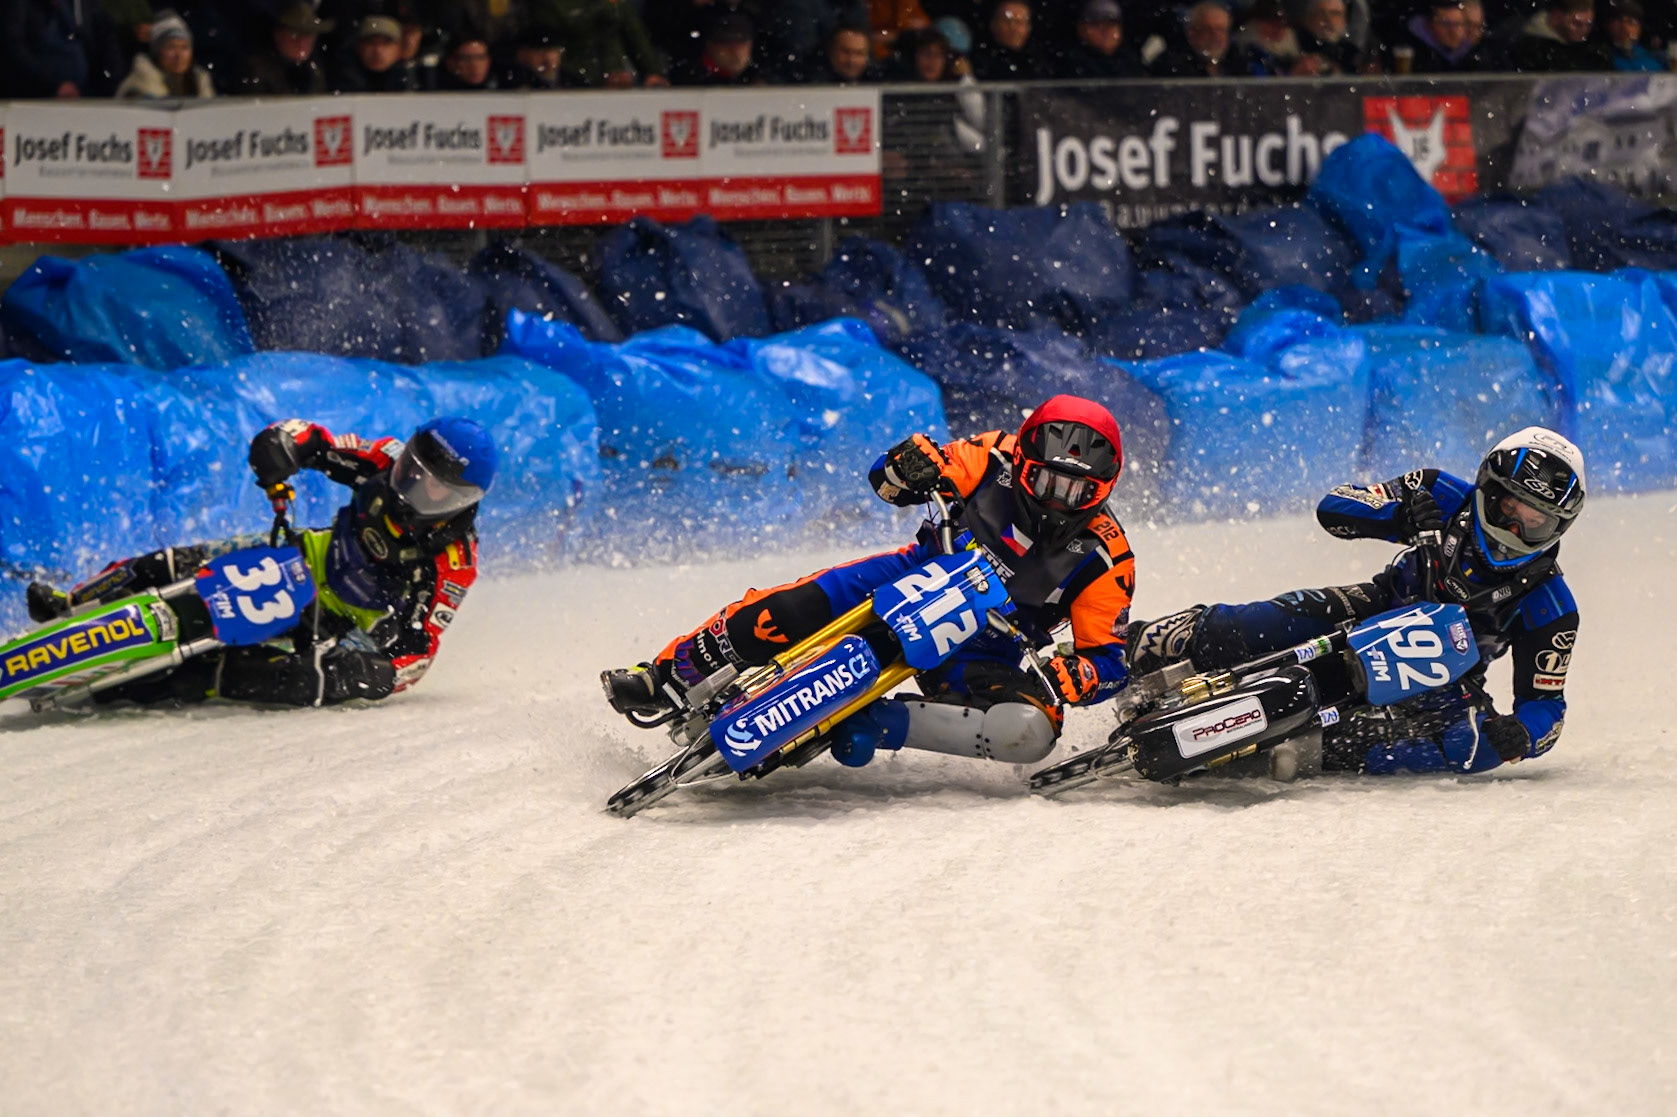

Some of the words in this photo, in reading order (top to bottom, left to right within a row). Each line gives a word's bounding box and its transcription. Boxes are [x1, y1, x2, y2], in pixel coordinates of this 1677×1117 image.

[14, 131, 71, 167] Josef
[76, 132, 133, 163] Fuchs
[185, 129, 245, 170] Josef
[250, 126, 309, 158] Fuchs
[363, 120, 419, 155] Josef
[424, 121, 481, 150] Fuchs
[537, 118, 592, 153] Josef
[597, 116, 655, 146] Fuchs
[709, 114, 765, 149] Josef
[770, 114, 828, 142] Fuchs
[1035, 115, 1180, 207] Josef
[214, 589, 236, 618] FIM
[223, 556, 295, 625] 33
[893, 562, 978, 656] 212
[899, 613, 922, 642] FIM
[5, 616, 145, 677] RAVENOL
[1366, 648, 1391, 681] FIM
[1377, 607, 1450, 691] 192
